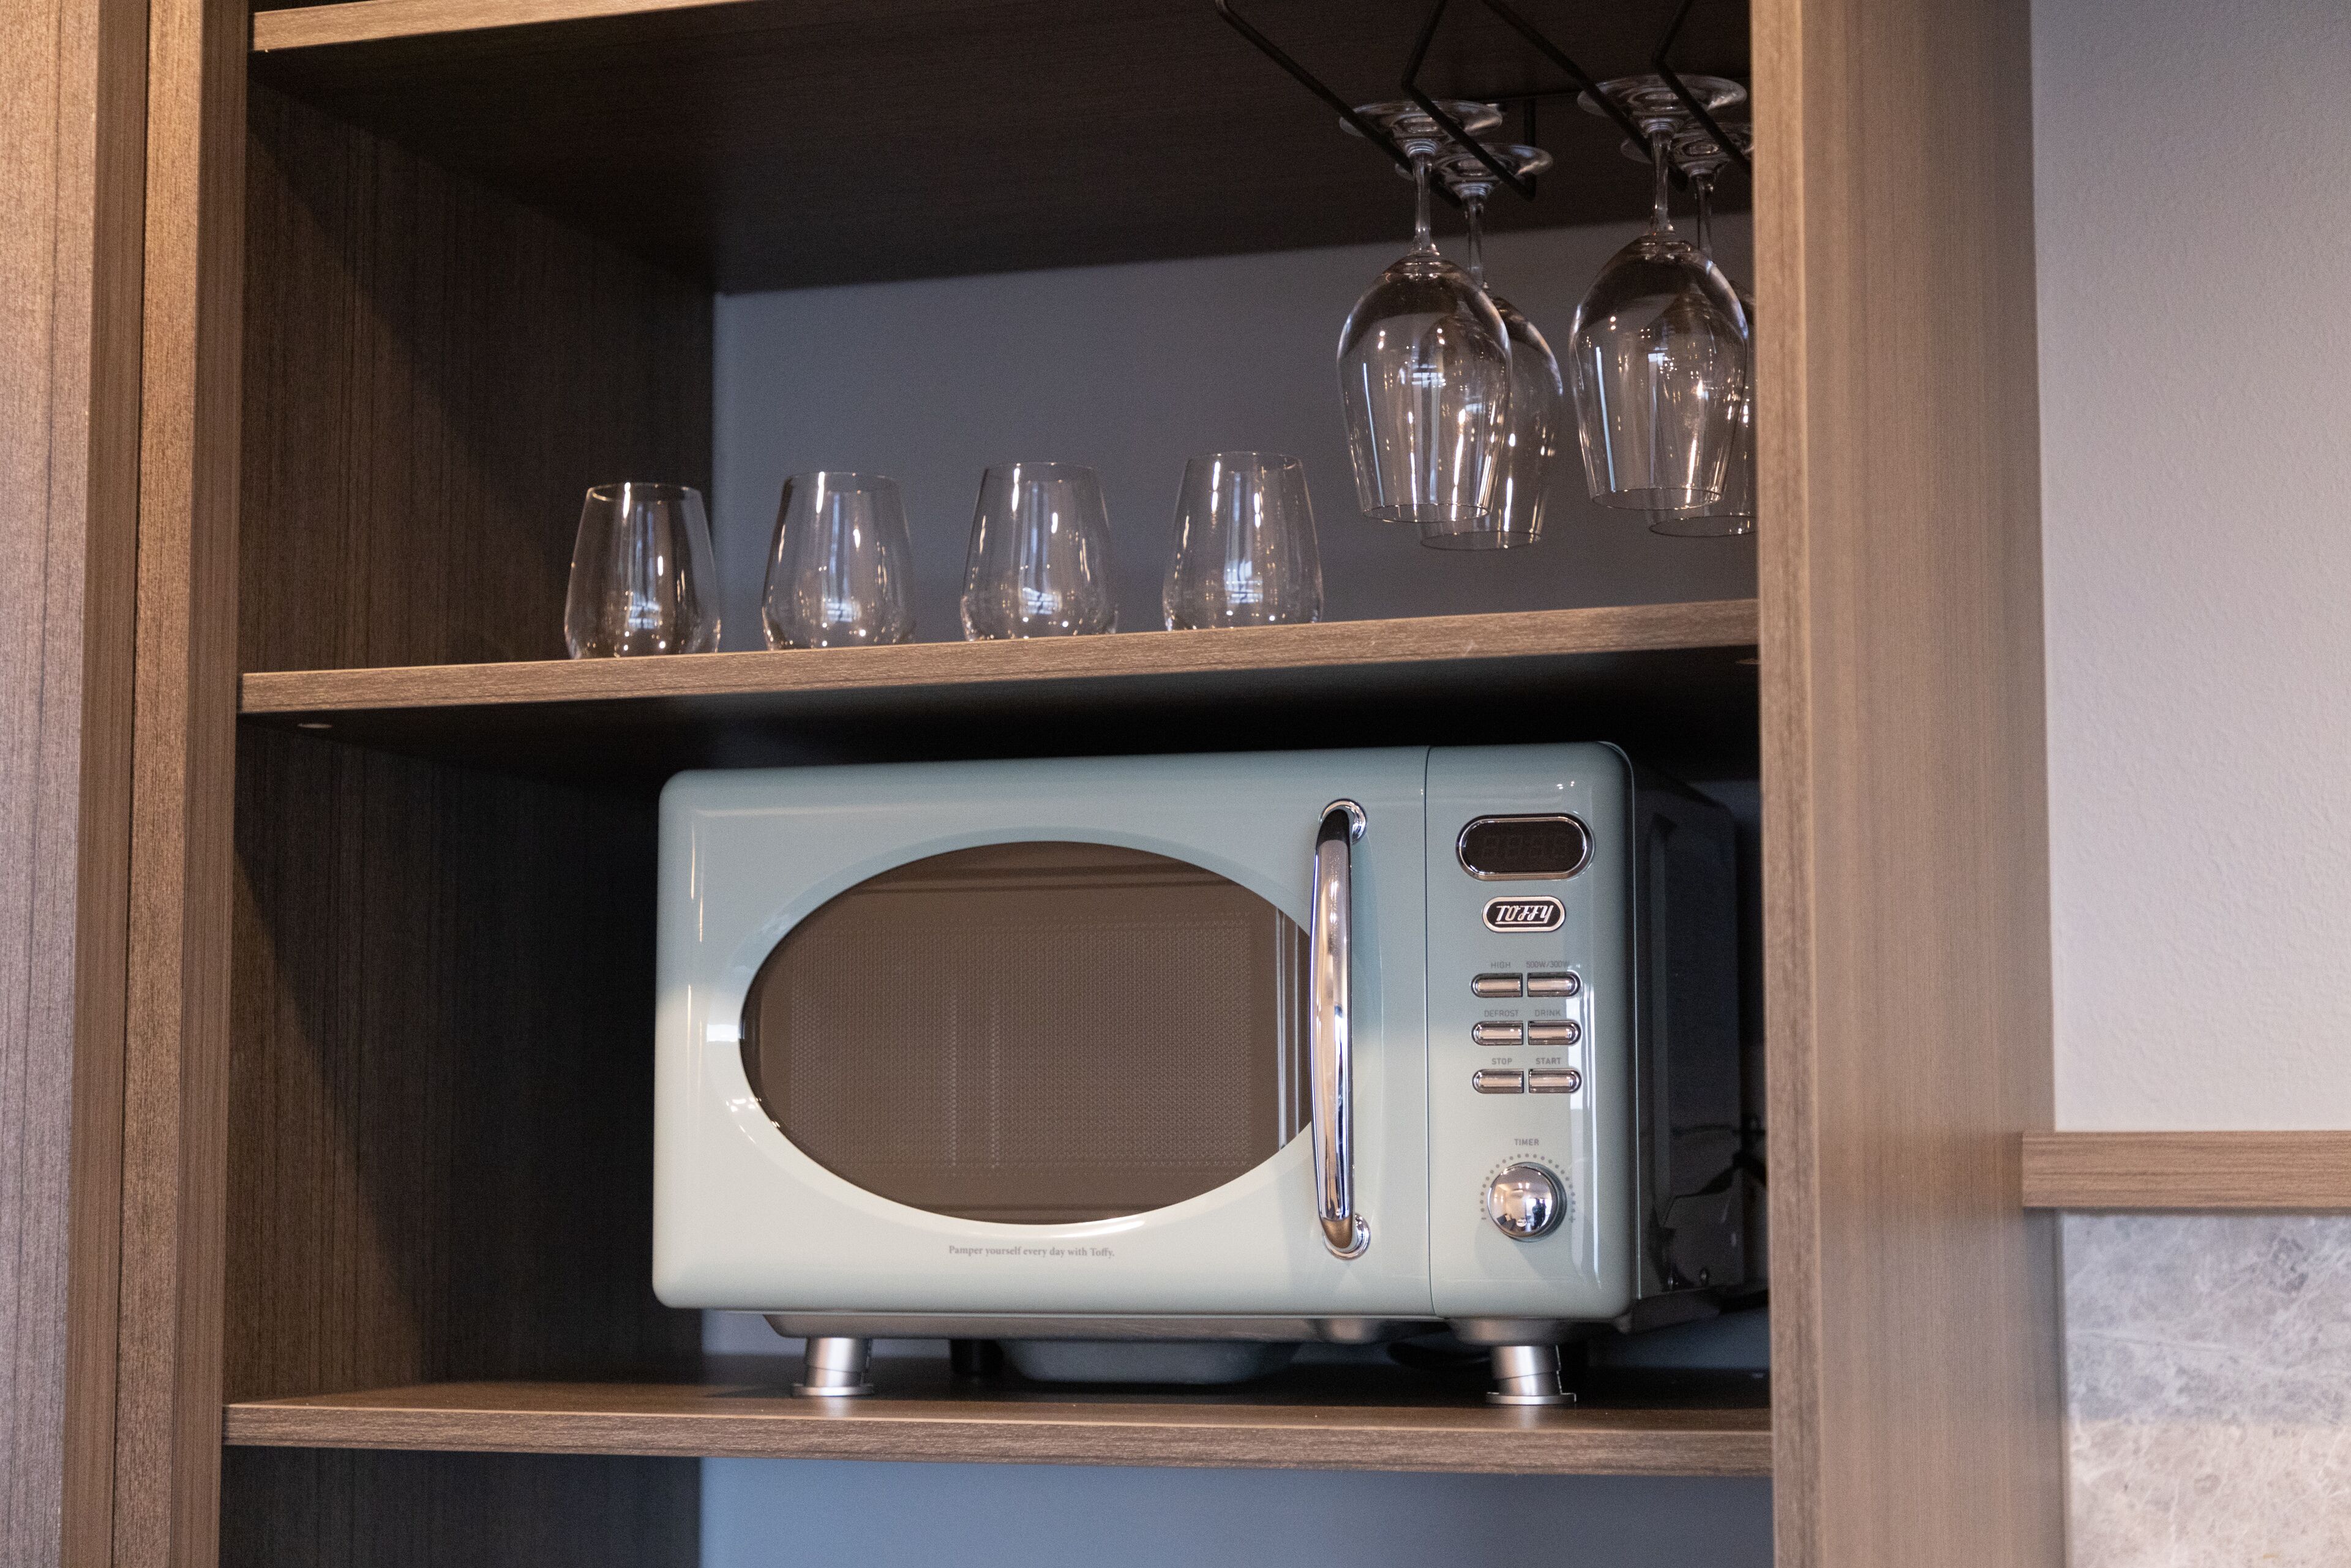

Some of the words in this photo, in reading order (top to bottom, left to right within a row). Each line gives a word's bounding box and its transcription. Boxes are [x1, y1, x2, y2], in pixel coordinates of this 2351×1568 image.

[949, 1245, 983, 1256] Pamper
[984, 1246, 1022, 1257] yourself
[1023, 1248, 1047, 1258] every
[1049, 1247, 1065, 1258] day
[1067, 1247, 1087, 1256] with
[1090, 1247, 1115, 1259] Toffy.
